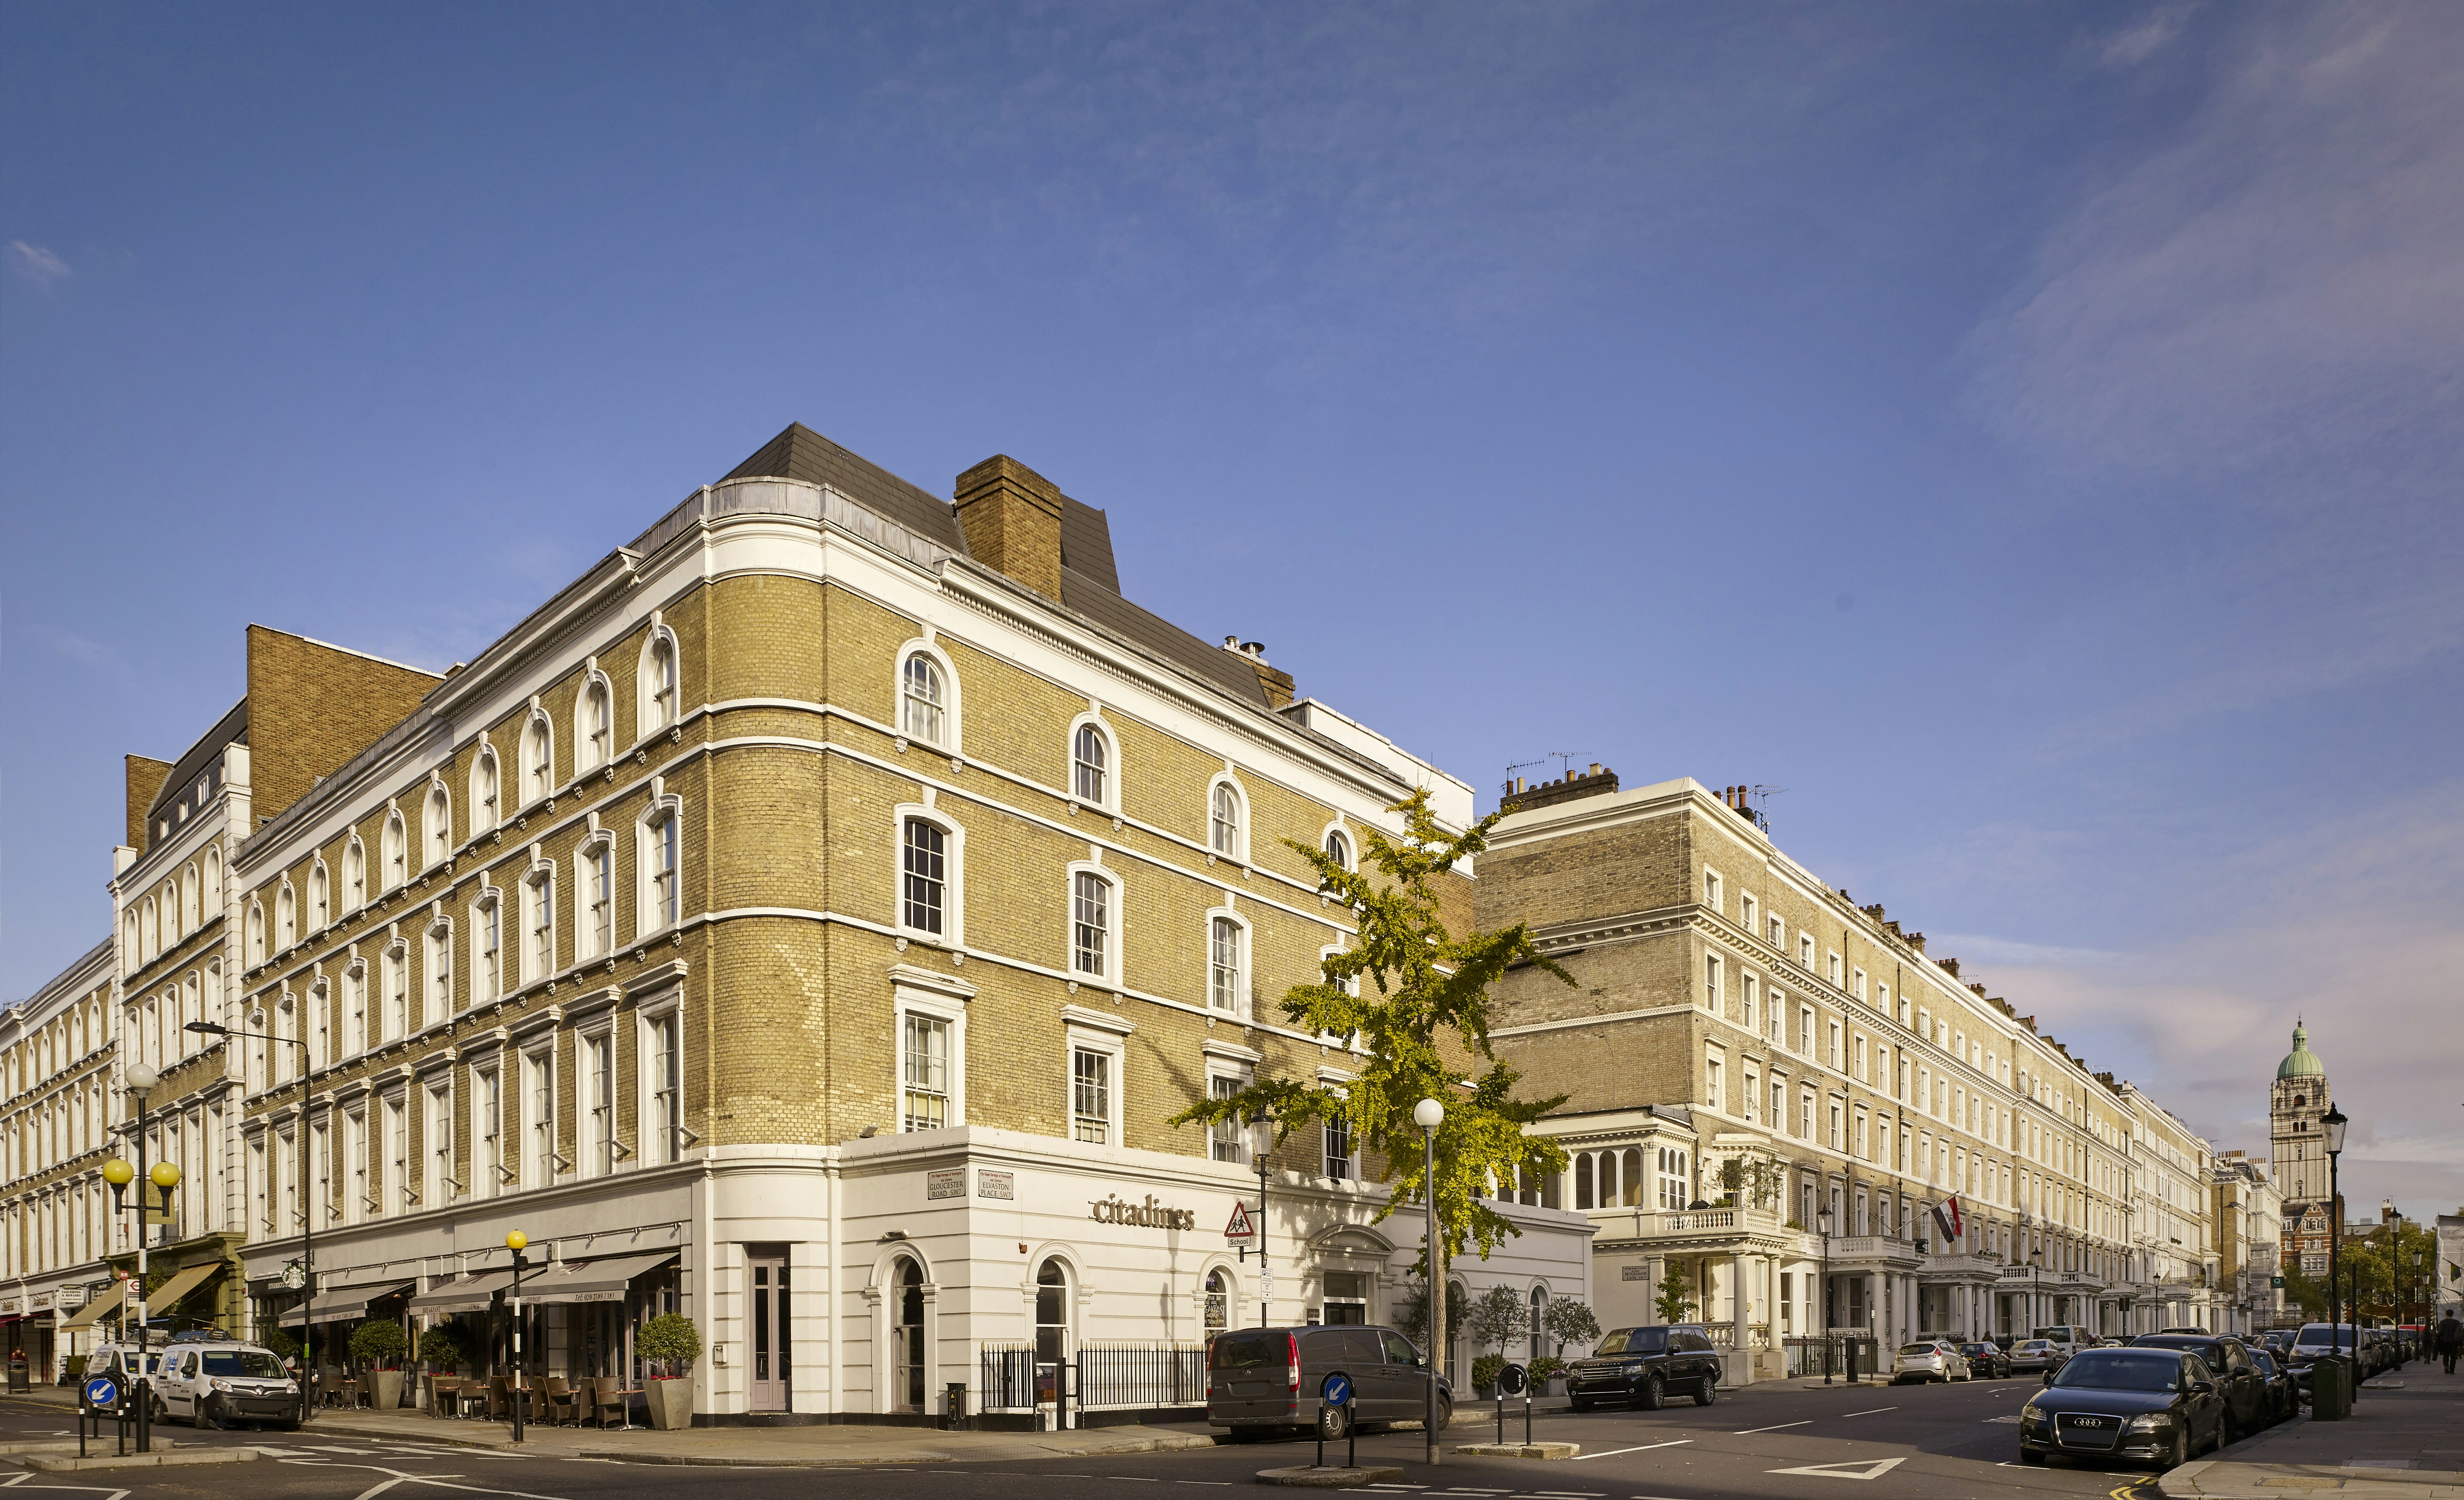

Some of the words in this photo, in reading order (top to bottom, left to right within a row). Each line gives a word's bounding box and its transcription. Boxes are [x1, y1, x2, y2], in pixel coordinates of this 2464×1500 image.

[929, 1181, 963, 1190] GLOUCESTER
[983, 1182, 1009, 1190] ELVASTON
[1093, 1193, 1195, 1229] citadines
[1205, 1305, 1225, 1317] EAKFAST
